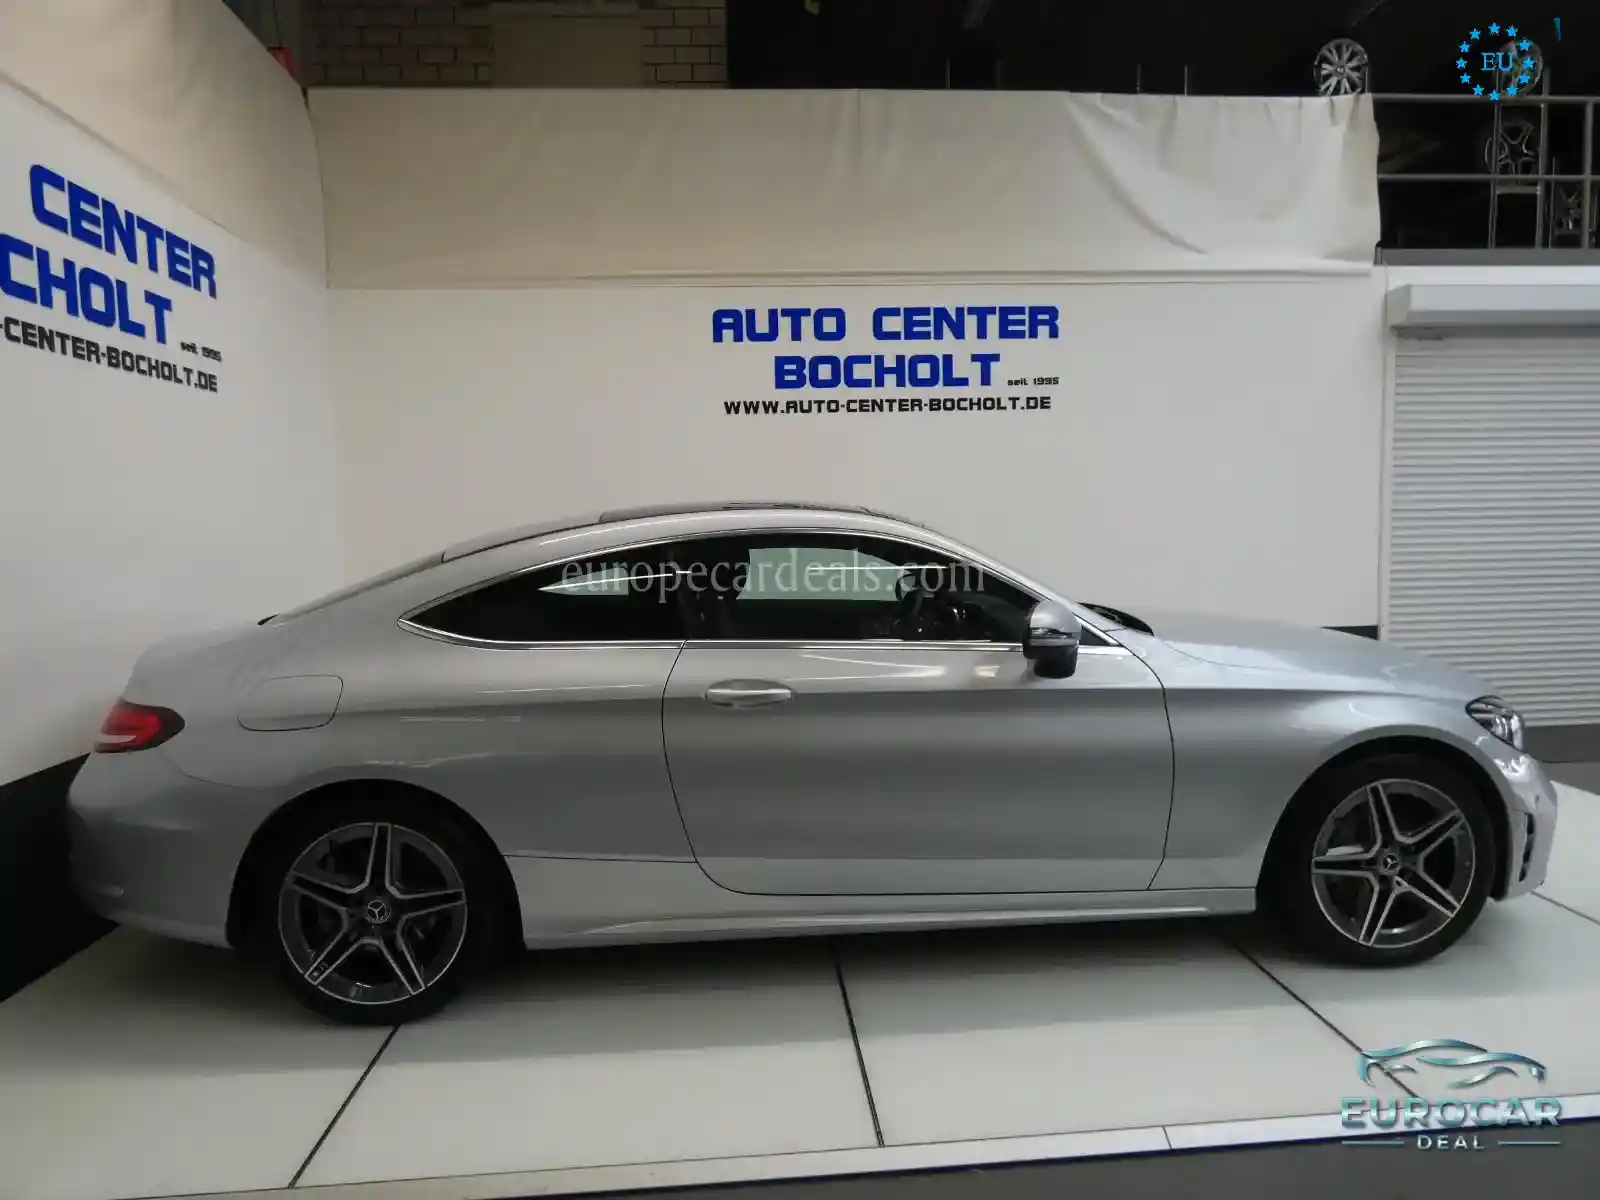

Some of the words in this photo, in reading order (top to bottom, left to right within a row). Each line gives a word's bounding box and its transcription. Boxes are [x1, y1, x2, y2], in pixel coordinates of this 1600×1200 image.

[30, 164, 217, 299] CENTER
[0, 233, 173, 345] CHOLT
[712, 308, 847, 342] AUTO
[872, 306, 1060, 341] CENTER
[774, 353, 1001, 389] BOCHOLT
[1007, 377, 1029, 386] seit
[1033, 376, 1060, 386] 1995
[724, 396, 1052, 415] WWW.AUTO-CENTER-BOCHOLT.DE
